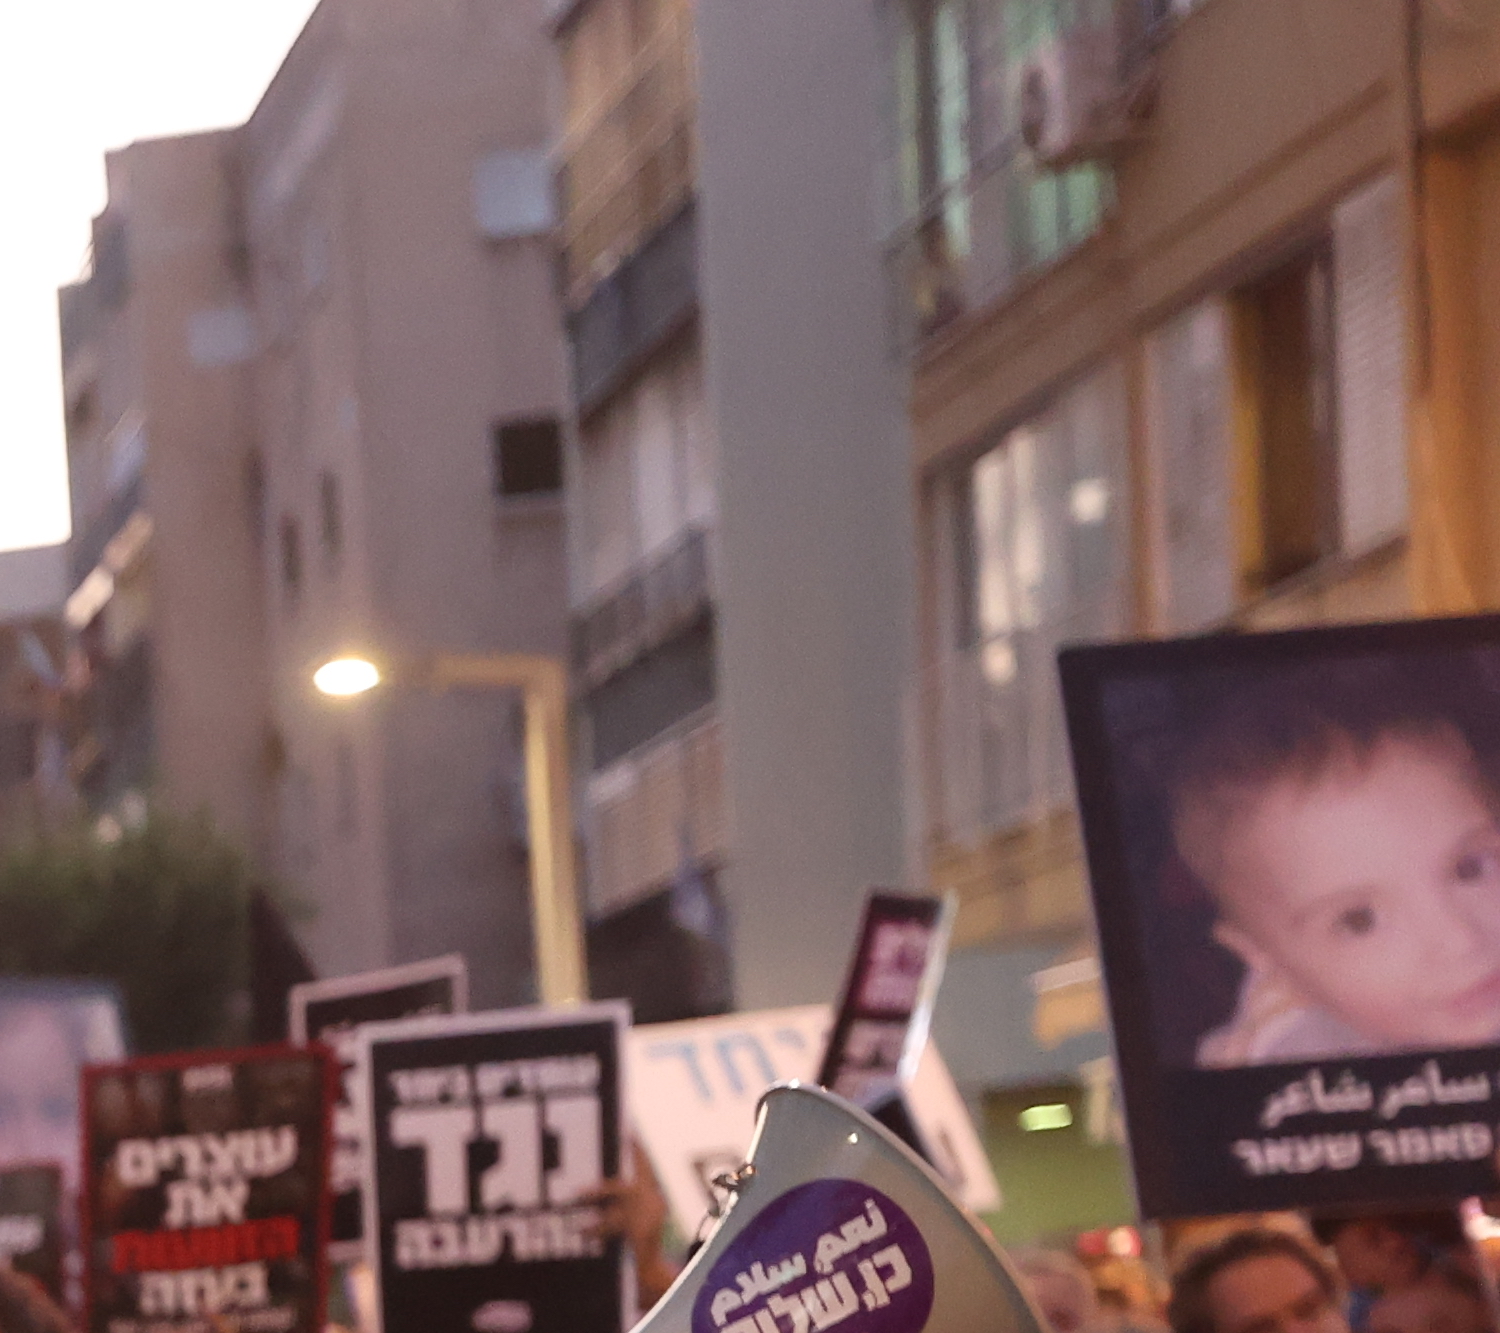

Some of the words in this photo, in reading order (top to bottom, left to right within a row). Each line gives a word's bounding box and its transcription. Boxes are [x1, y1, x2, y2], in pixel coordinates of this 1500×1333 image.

[116, 1124, 299, 1188] עוצרים
[389, 1098, 604, 1216] נגד
[710, 1251, 808, 1328] سلام
